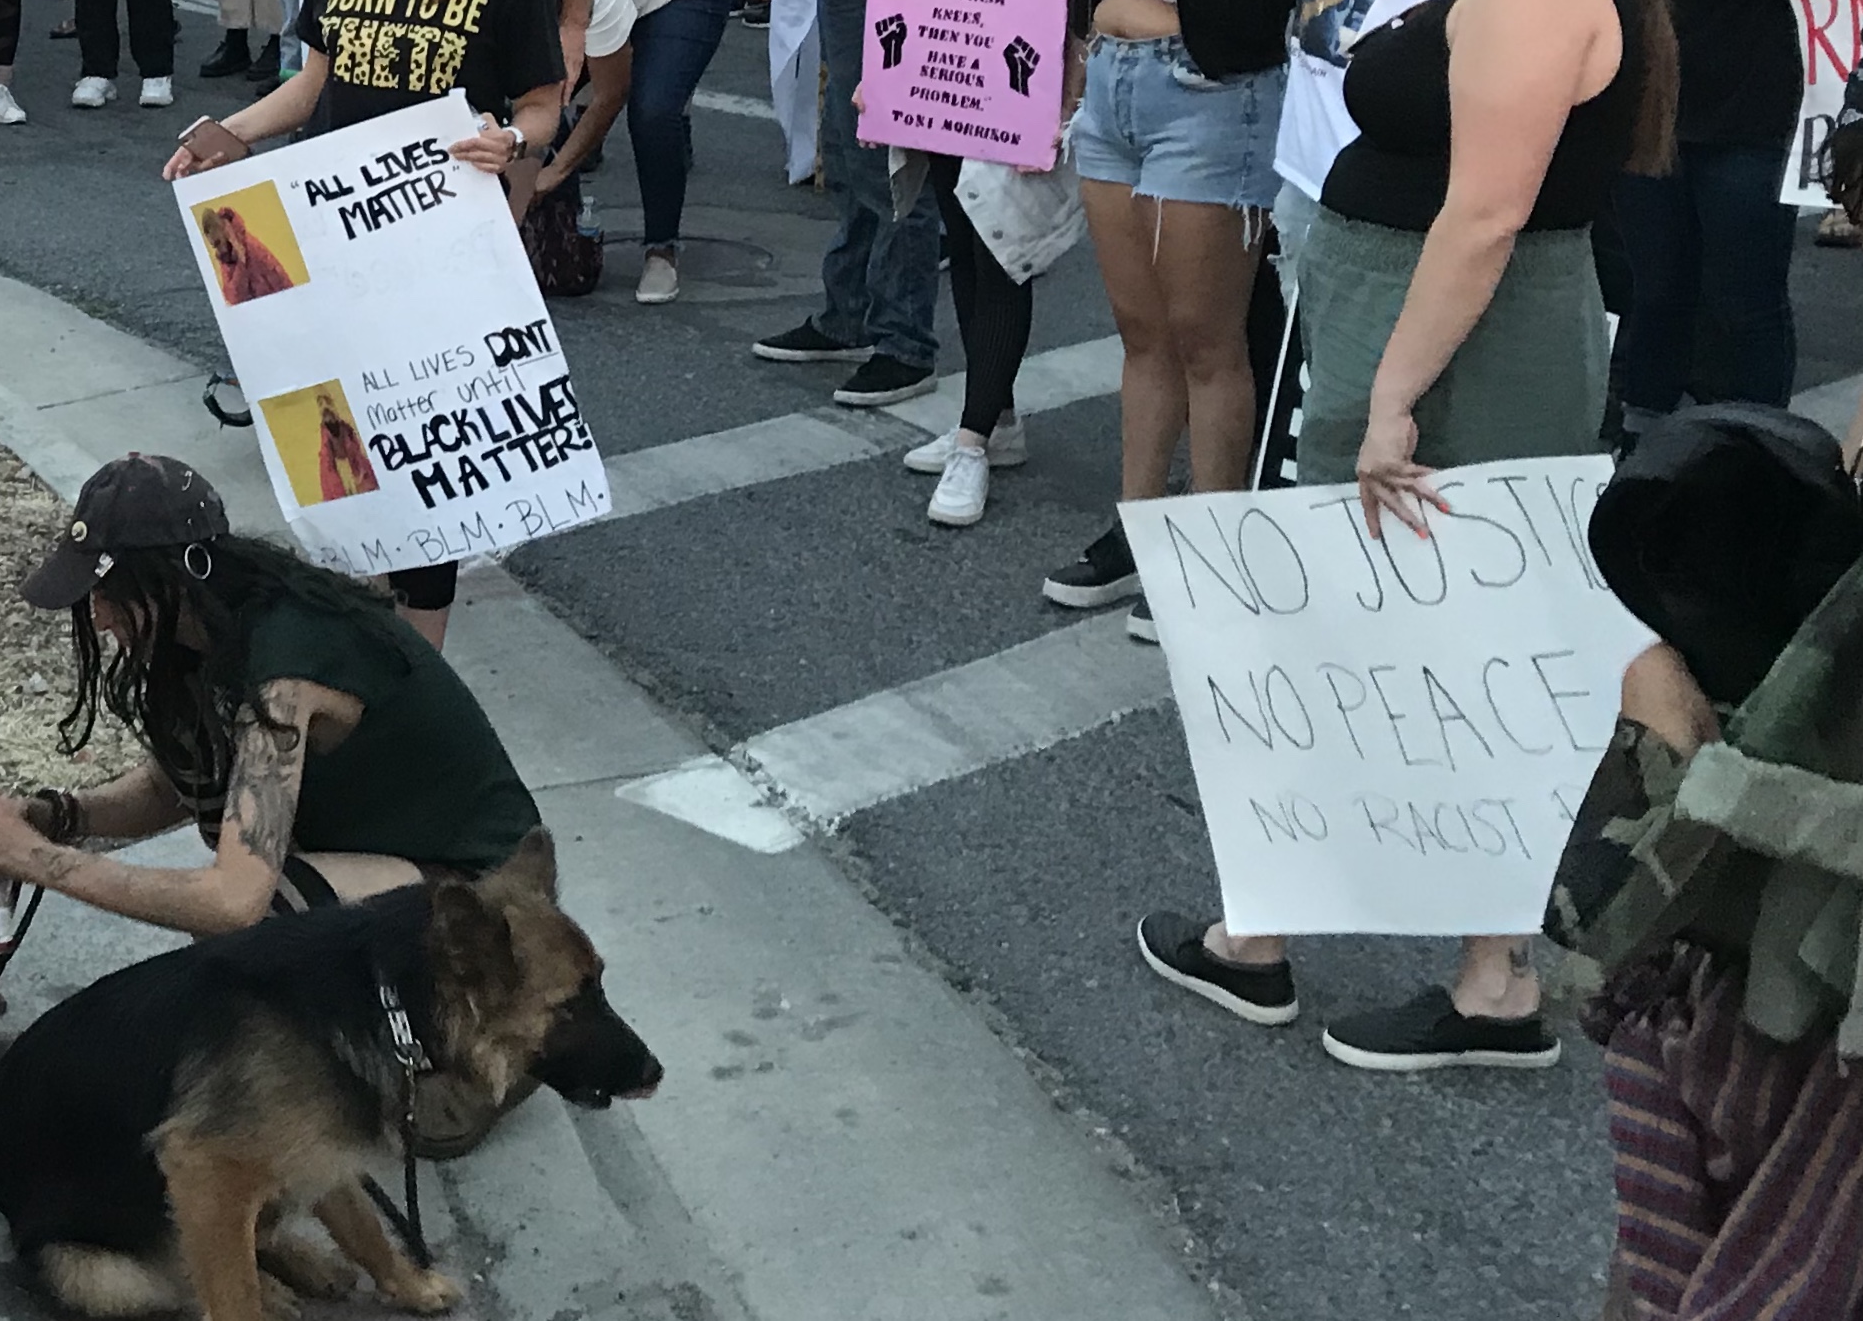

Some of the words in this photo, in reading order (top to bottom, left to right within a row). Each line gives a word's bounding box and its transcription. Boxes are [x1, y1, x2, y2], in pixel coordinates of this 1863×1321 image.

[918, 25, 960, 43] THEN
[963, 31, 995, 50] YOU
[927, 50, 967, 68] HAVE
[970, 57, 980, 70] A
[919, 65, 986, 89] SERIOUS
[891, 110, 934, 130] TONI
[940, 118, 1021, 146] MORRISON
[360, 138, 451, 181] LIVES
[361, 367, 400, 393] ALL
[409, 344, 475, 383] LIVES
[369, 405, 482, 472] BLACK
[410, 421, 594, 509] MATTER!
[1163, 505, 1311, 616] NO
[1206, 663, 1316, 752] NO
[1316, 649, 1610, 772] PEACE
[1248, 794, 1329, 845] NO
[1351, 794, 1533, 861] RACIST
